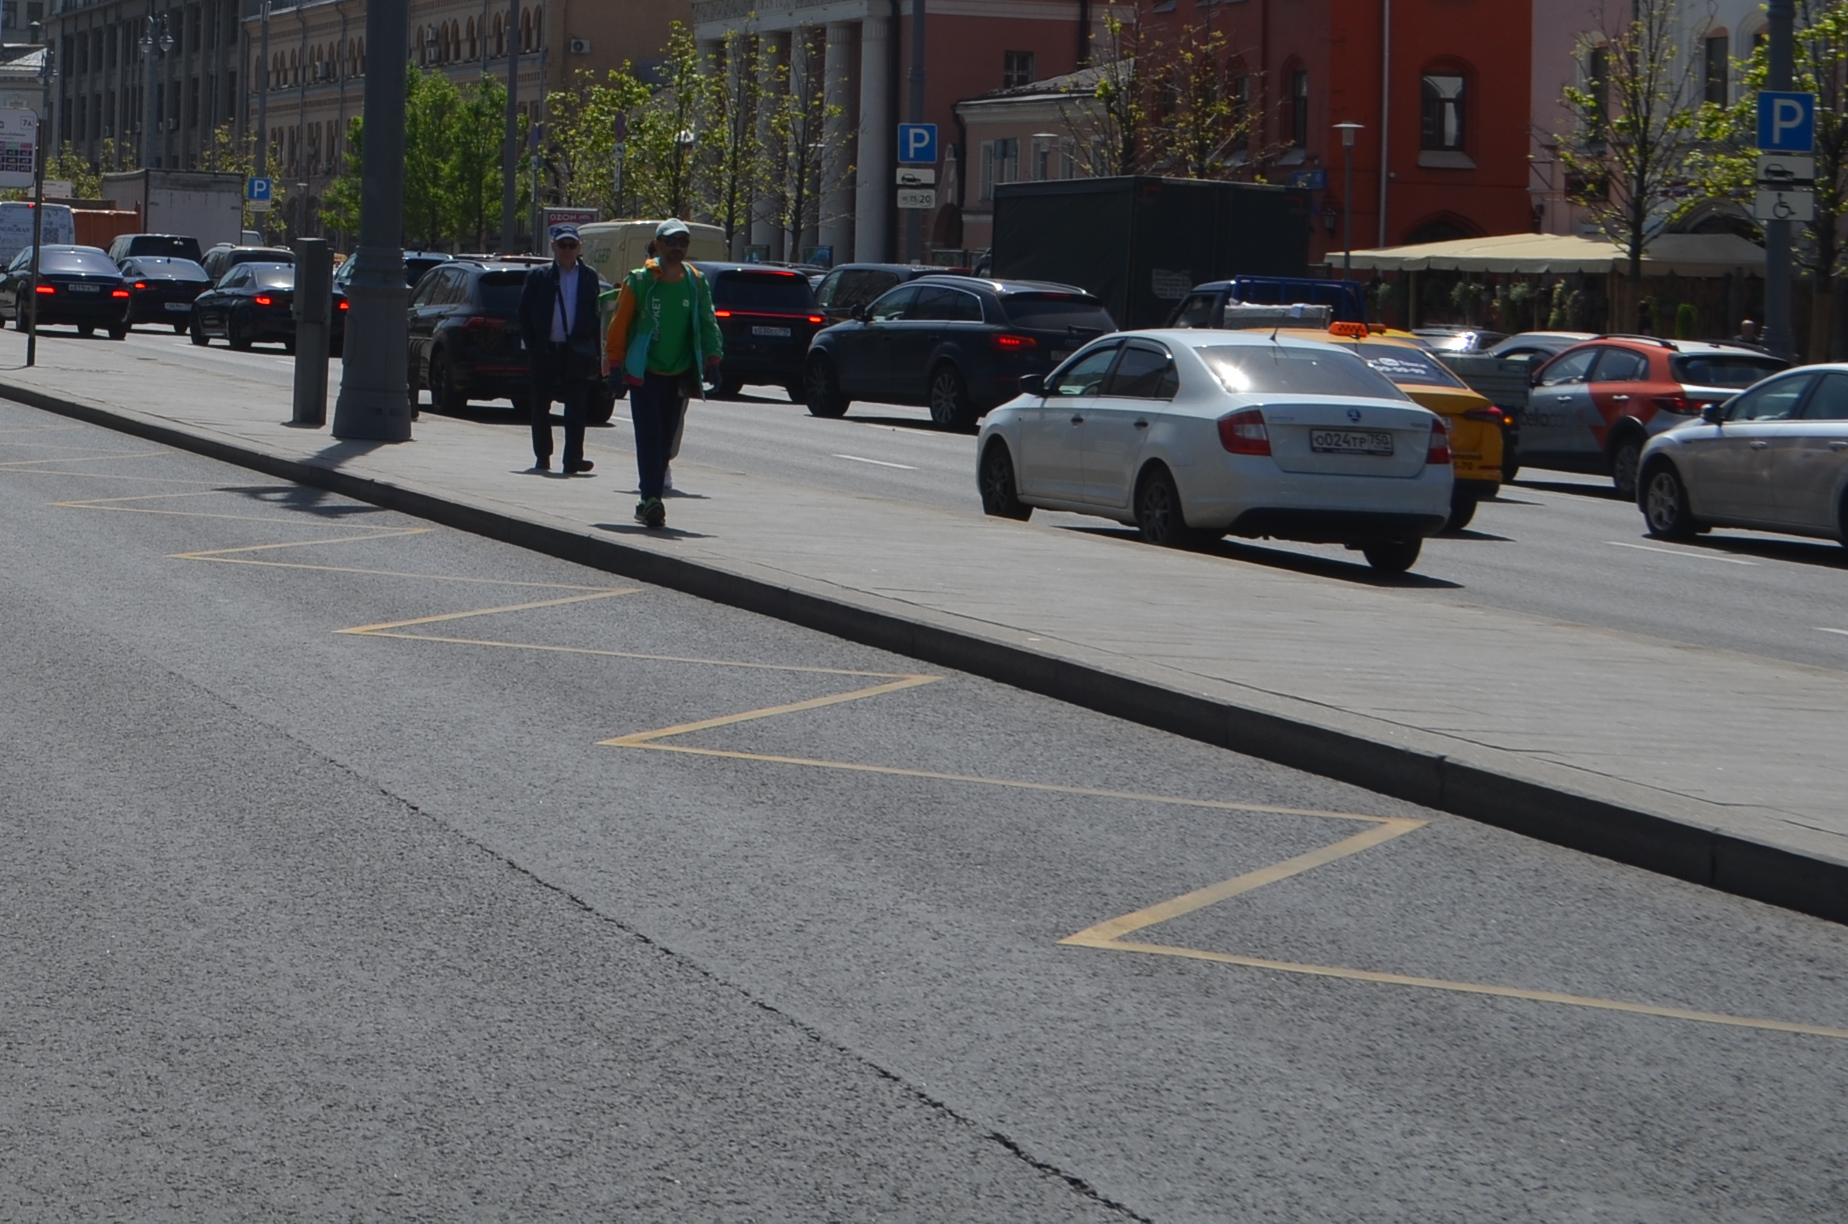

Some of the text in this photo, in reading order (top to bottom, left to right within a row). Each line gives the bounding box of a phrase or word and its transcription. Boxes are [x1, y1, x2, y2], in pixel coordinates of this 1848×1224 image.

[1772, 98, 1804, 144] P
[909, 128, 930, 159] P
[253, 180, 267, 198] P
[919, 195, 931, 203] 20
[549, 214, 577, 222] OZON
[1315, 432, 1367, 448] О024ТР
